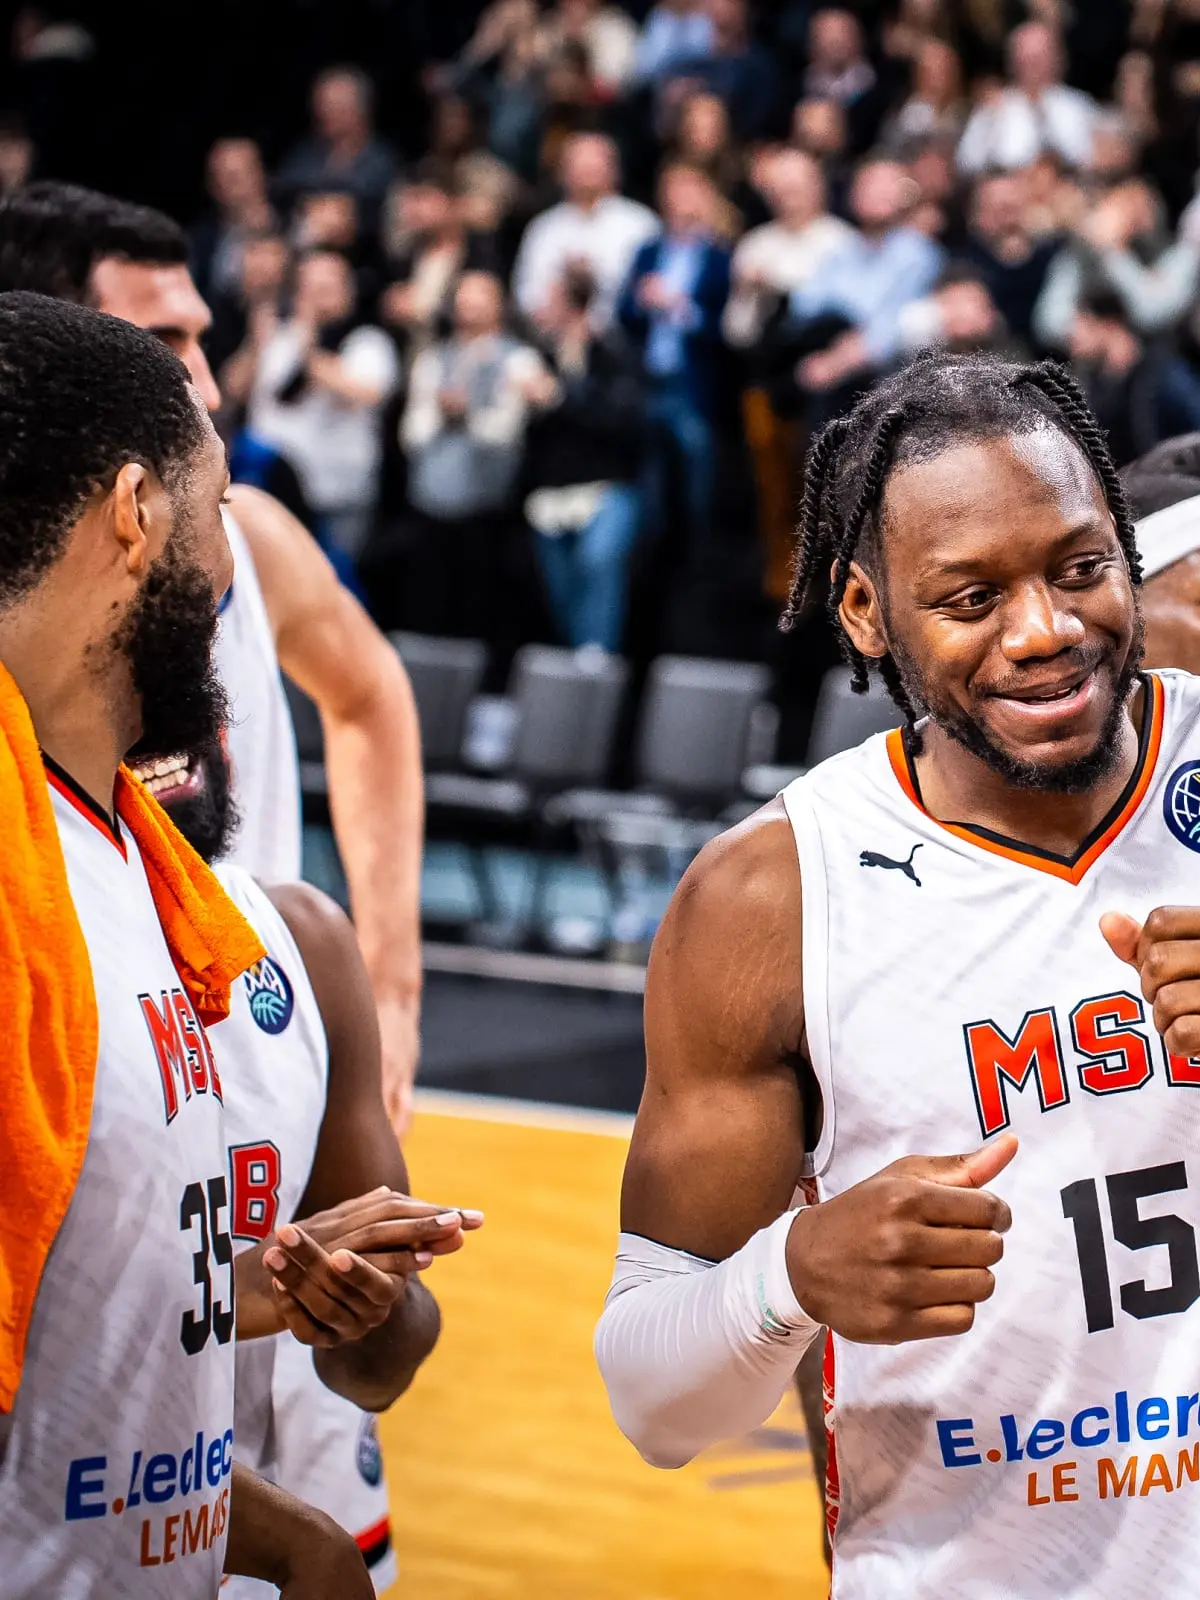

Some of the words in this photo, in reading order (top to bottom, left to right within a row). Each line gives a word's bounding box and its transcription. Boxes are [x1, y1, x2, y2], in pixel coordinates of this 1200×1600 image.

[137, 988, 224, 1126] MS
[180, 1176, 235, 1355] 35
[1060, 1161, 1200, 1333] 15
[140, 1514, 180, 1567] LE
[1027, 1462, 1079, 1506] LE
